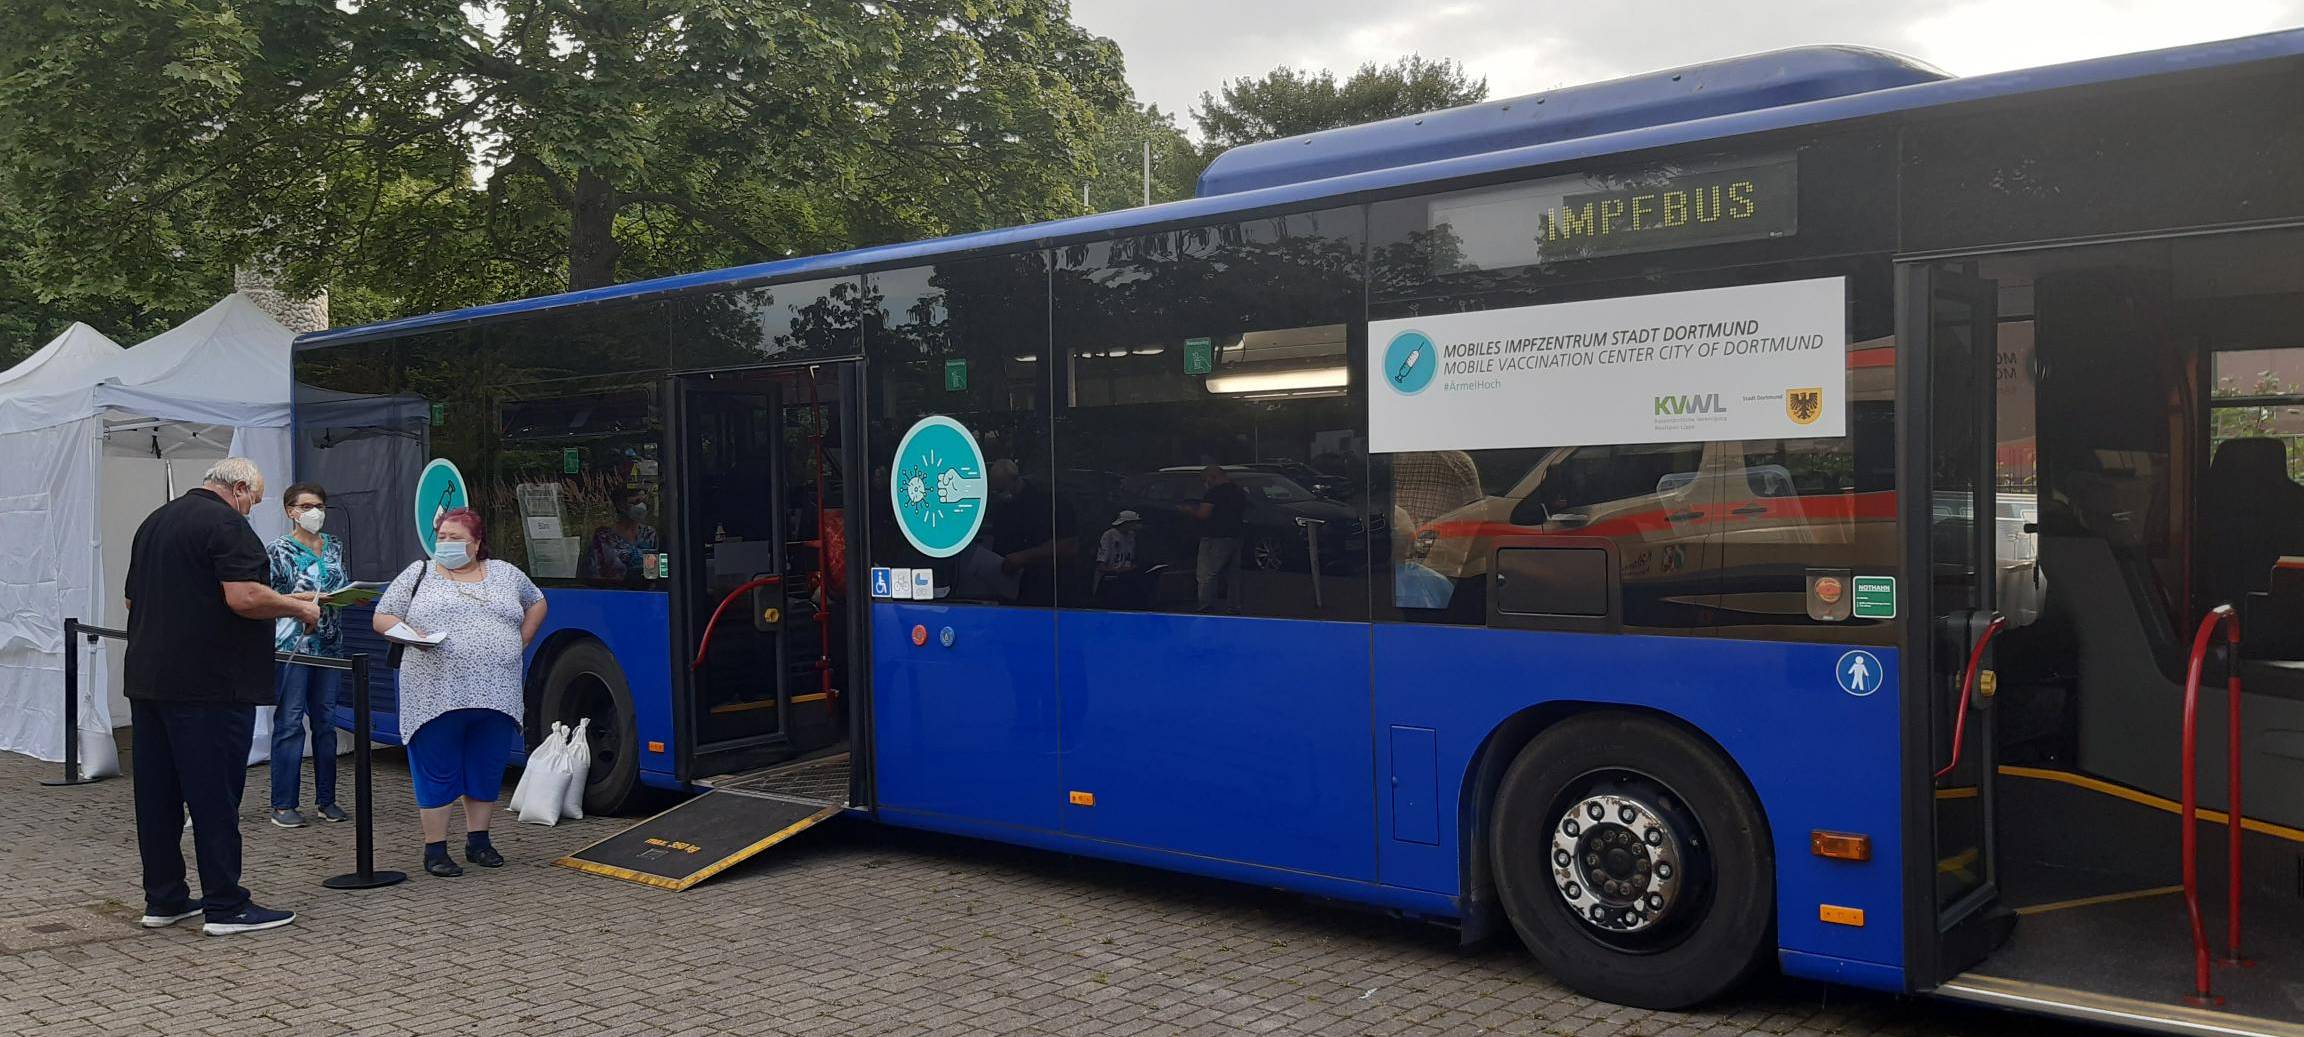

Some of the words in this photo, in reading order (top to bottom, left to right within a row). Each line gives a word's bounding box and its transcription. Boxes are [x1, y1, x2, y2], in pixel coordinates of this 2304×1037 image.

[1548, 181, 1755, 241] IMPFBUS
[1443, 340, 1501, 359] MOBILES
[1504, 332, 1608, 354] IMPFZENTRUM
[1611, 327, 1661, 346] STADT
[1663, 319, 1759, 342] DORTMUND
[1443, 359, 1494, 375] MOBILE
[1499, 350, 1594, 372] VACCINATION
[1598, 347, 1655, 365] CENTER
[1659, 344, 1694, 360] CITY
[1697, 342, 1720, 358] OF
[1723, 334, 1824, 356] DORTMUND
[1654, 393, 1727, 416] KVWL
